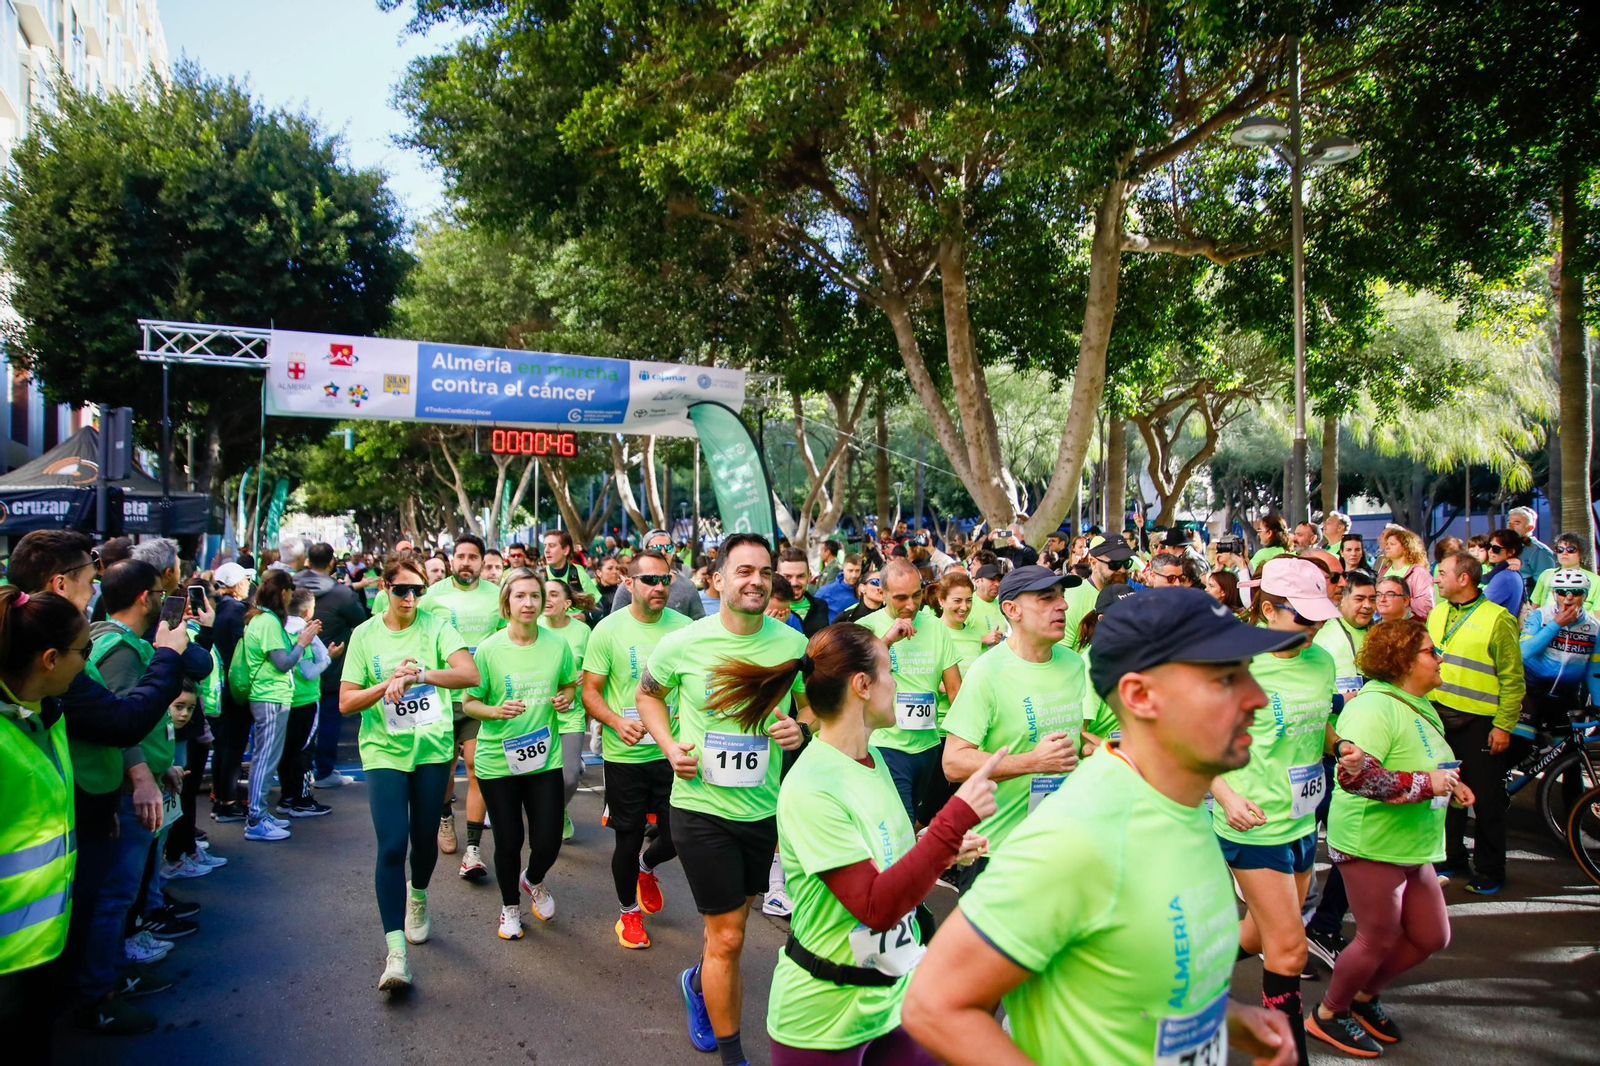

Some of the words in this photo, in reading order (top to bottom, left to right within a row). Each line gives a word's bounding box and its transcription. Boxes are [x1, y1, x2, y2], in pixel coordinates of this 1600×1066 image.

[431, 352, 512, 374] Almería
[517, 362, 541, 375] en
[548, 364, 619, 381] marcha
[652, 372, 687, 382] cajamar
[431, 378, 498, 395] contra
[504, 380, 523, 397] el
[528, 382, 595, 401] cáncer
[1558, 630, 1589, 641] ESTORE
[395, 697, 430, 716] 696
[906, 704, 931, 717] 730
[1270, 692, 1284, 737] ALMERÍA
[1285, 704, 1297, 713] En
[1022, 696, 1037, 743] ALMERÍA
[1040, 714, 1072, 728] contra
[1287, 711, 1318, 724] contra
[516, 741, 547, 762] 386
[716, 751, 758, 770] 116
[1301, 776, 1322, 798] 465
[1167, 895, 1190, 1009] ALMERÍA
